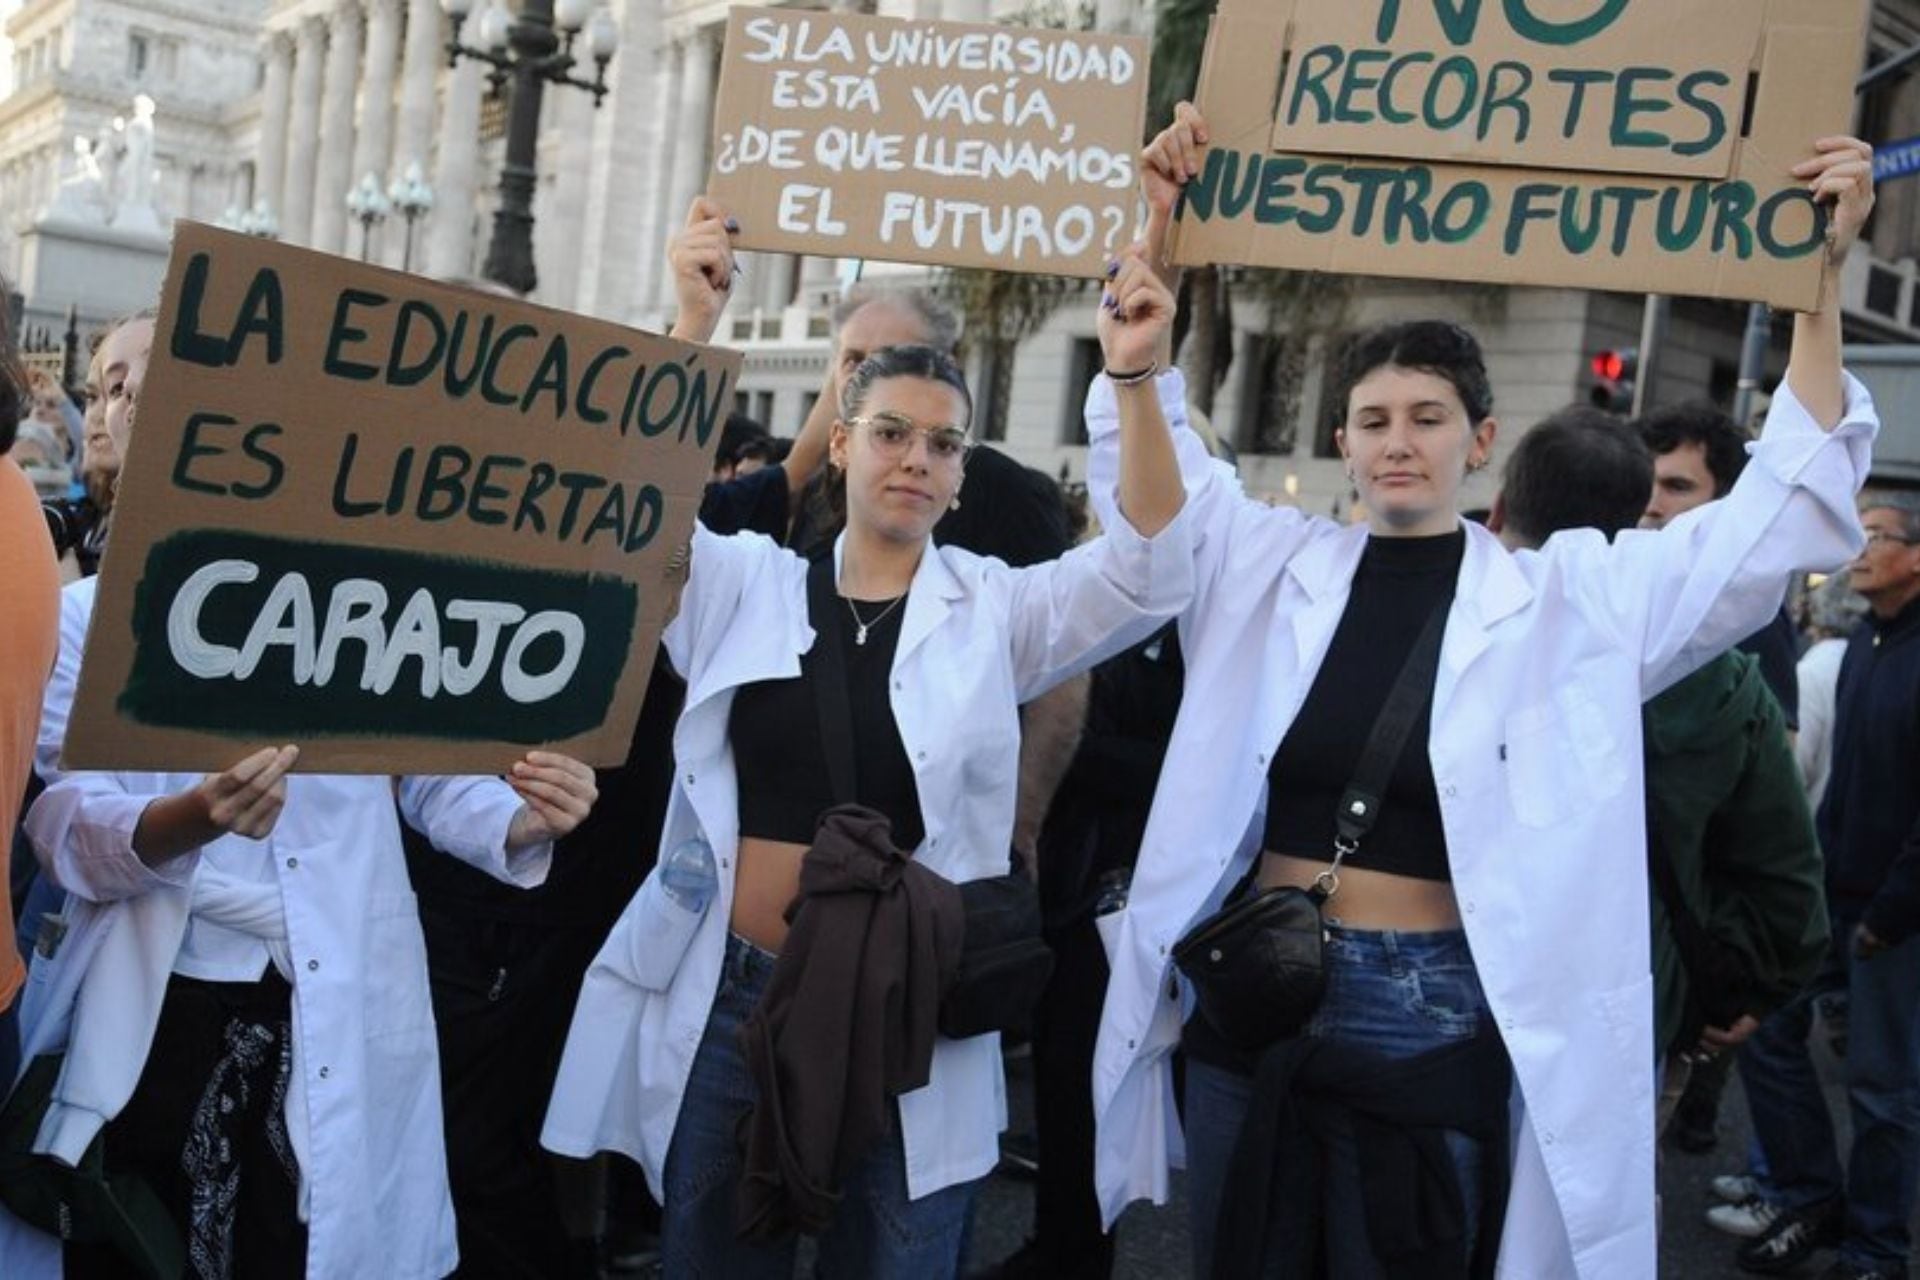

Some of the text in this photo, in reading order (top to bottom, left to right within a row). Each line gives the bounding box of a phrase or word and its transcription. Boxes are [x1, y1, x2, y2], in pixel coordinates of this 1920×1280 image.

[772, 65, 1075, 143] ESTÁ VACÍA,
[1287, 44, 1730, 155] RECORTES
[717, 126, 1133, 188] ¿DE QUE LLENAMOS
[777, 184, 846, 236] EL
[1173, 147, 1826, 258] NUESTRO FUTURO
[170, 253, 728, 448] LA EDUCACIÓN
[171, 413, 663, 553] ES LIBERTAD
[167, 559, 586, 702] CARAJO
